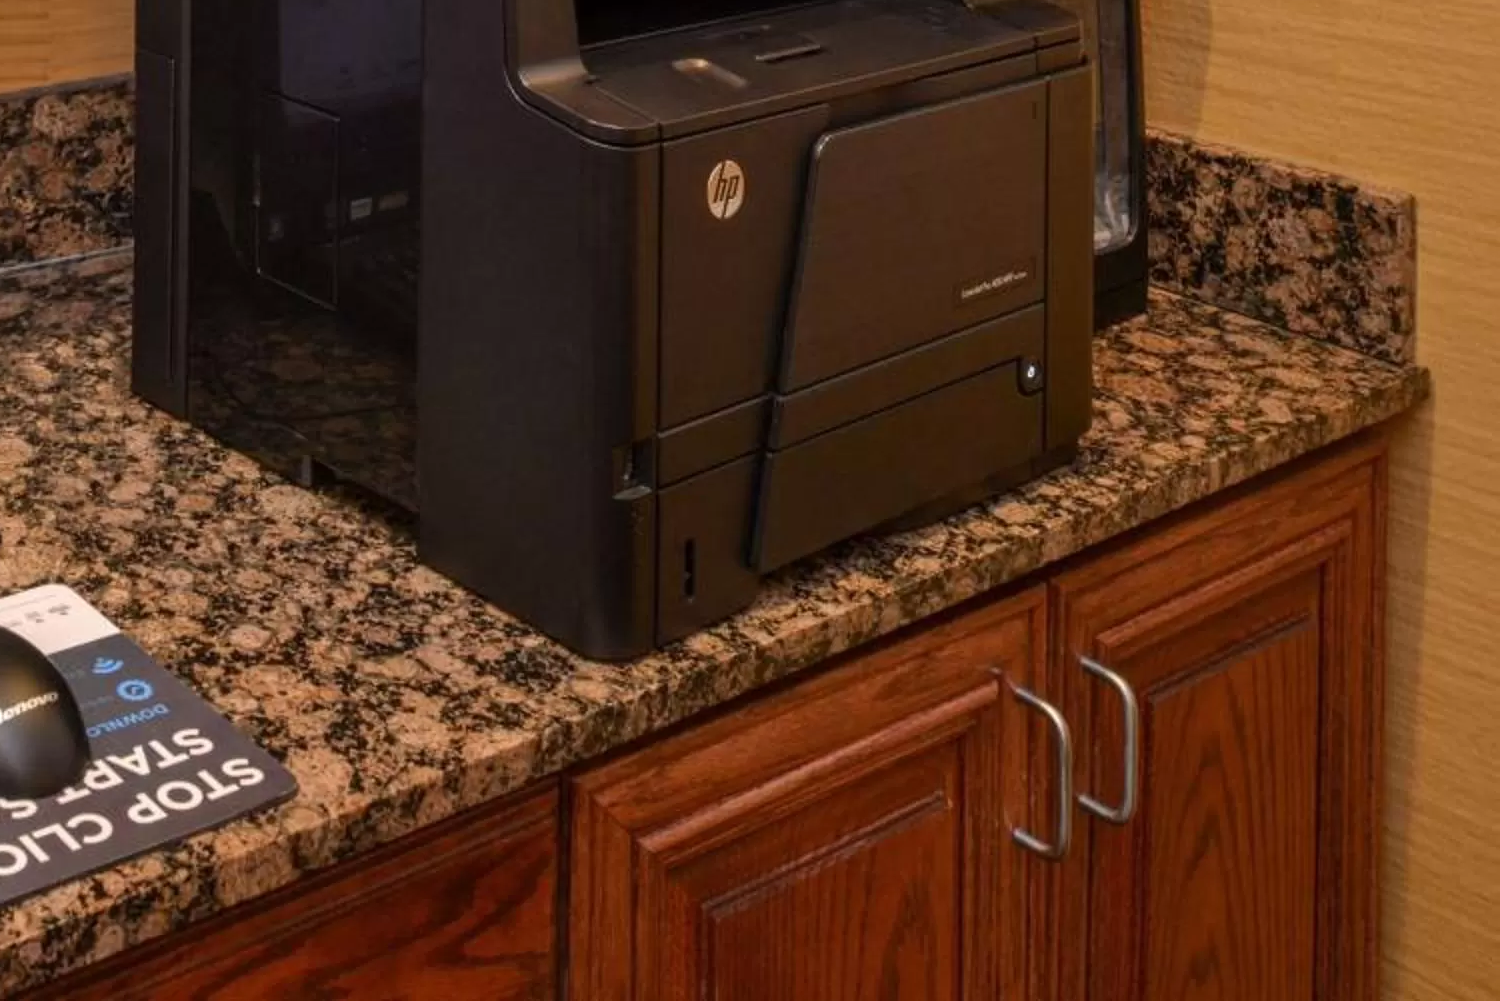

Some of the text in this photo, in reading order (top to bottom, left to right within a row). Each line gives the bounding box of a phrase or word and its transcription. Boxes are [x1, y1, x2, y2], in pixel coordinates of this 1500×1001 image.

[710, 160, 741, 219] hp
[55, 727, 215, 806] START
[126, 757, 265, 825] STOP
